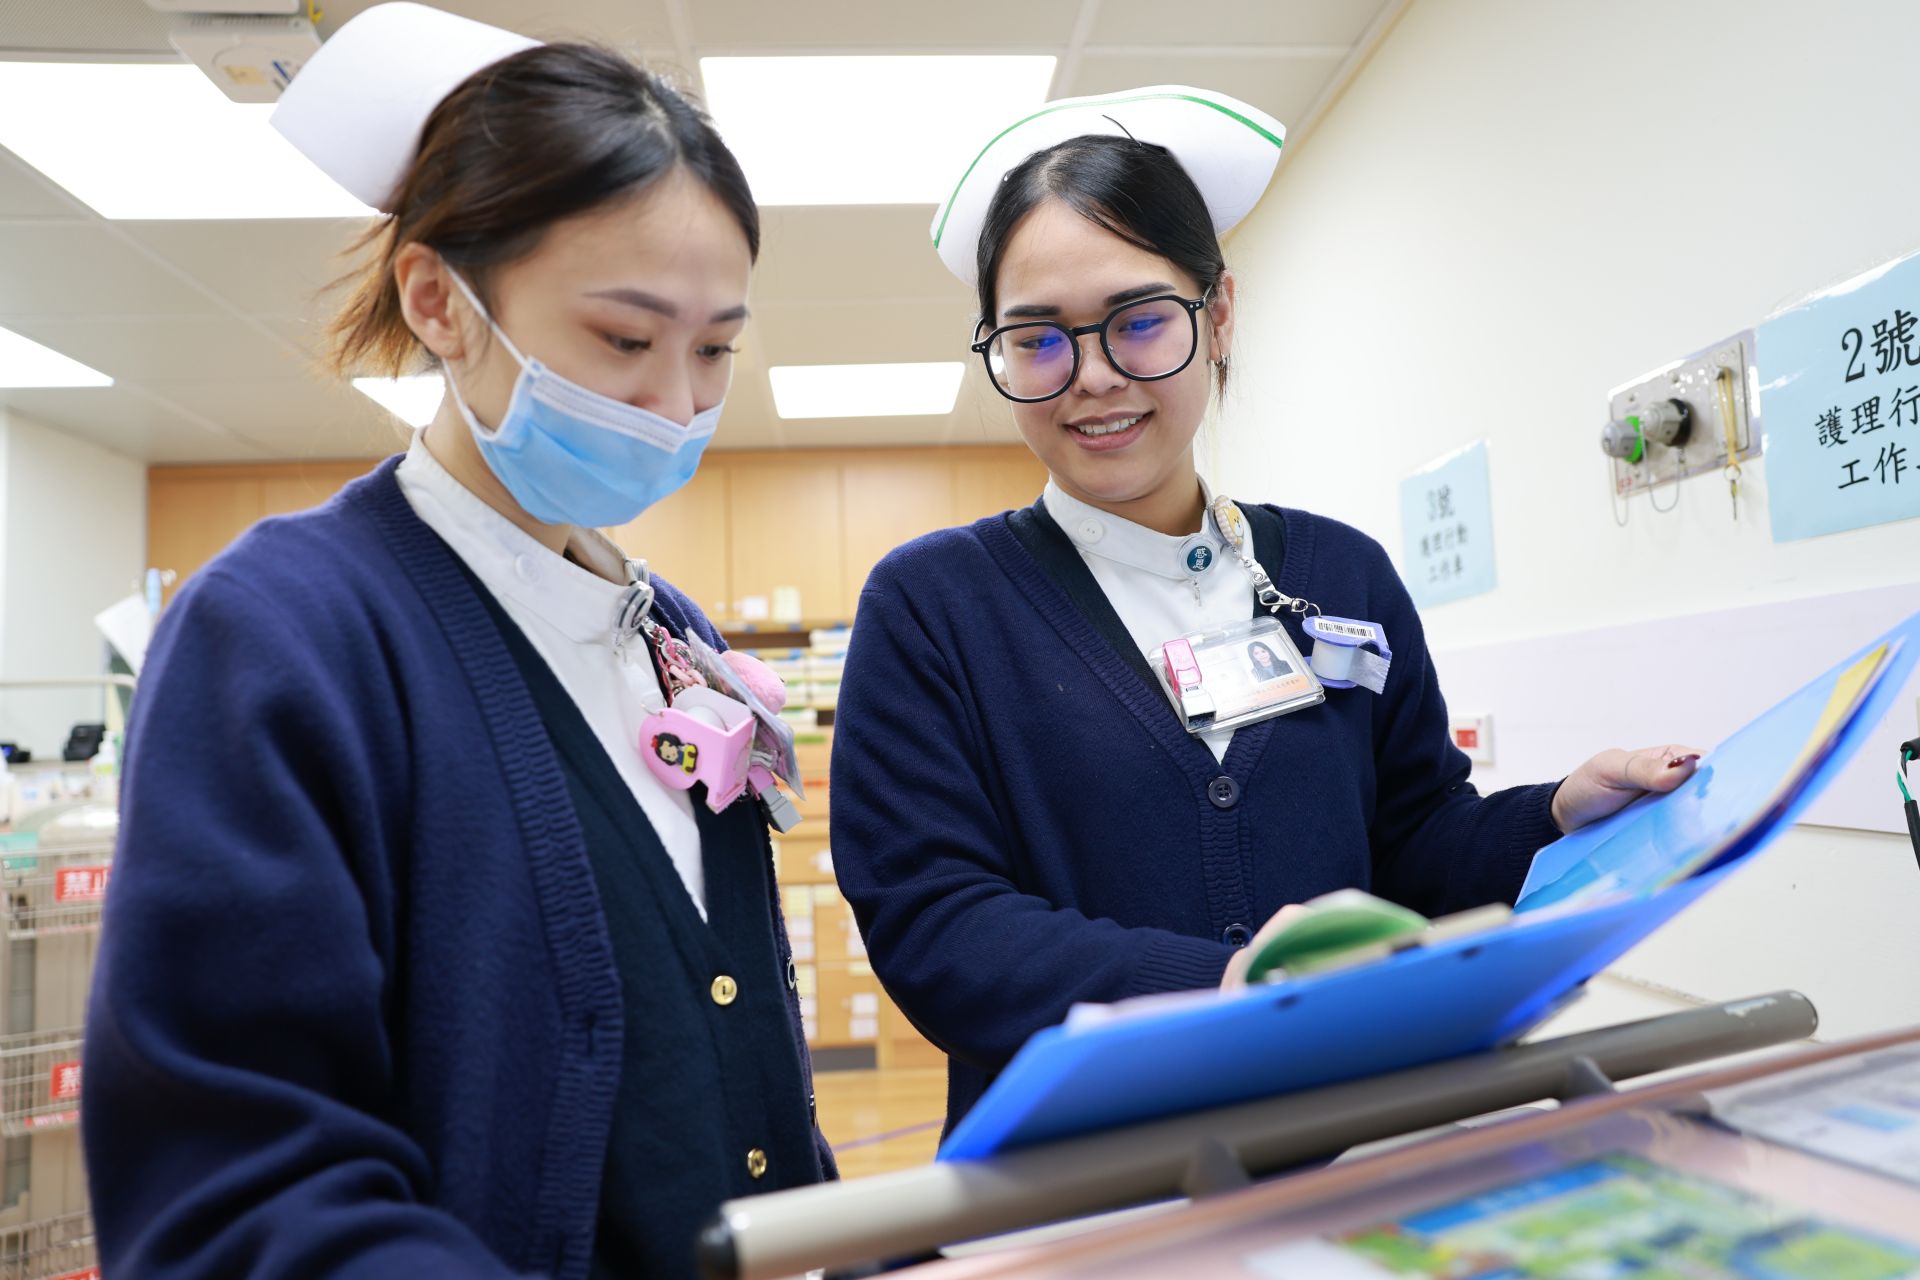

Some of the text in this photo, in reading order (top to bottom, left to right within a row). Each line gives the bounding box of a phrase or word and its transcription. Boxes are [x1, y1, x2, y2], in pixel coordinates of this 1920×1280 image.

[1841, 309, 1920, 383] 2號
[1814, 385, 1920, 448] 護理行
[1838, 441, 1920, 489] 工作
[1192, 547, 1207, 569] 感恩
